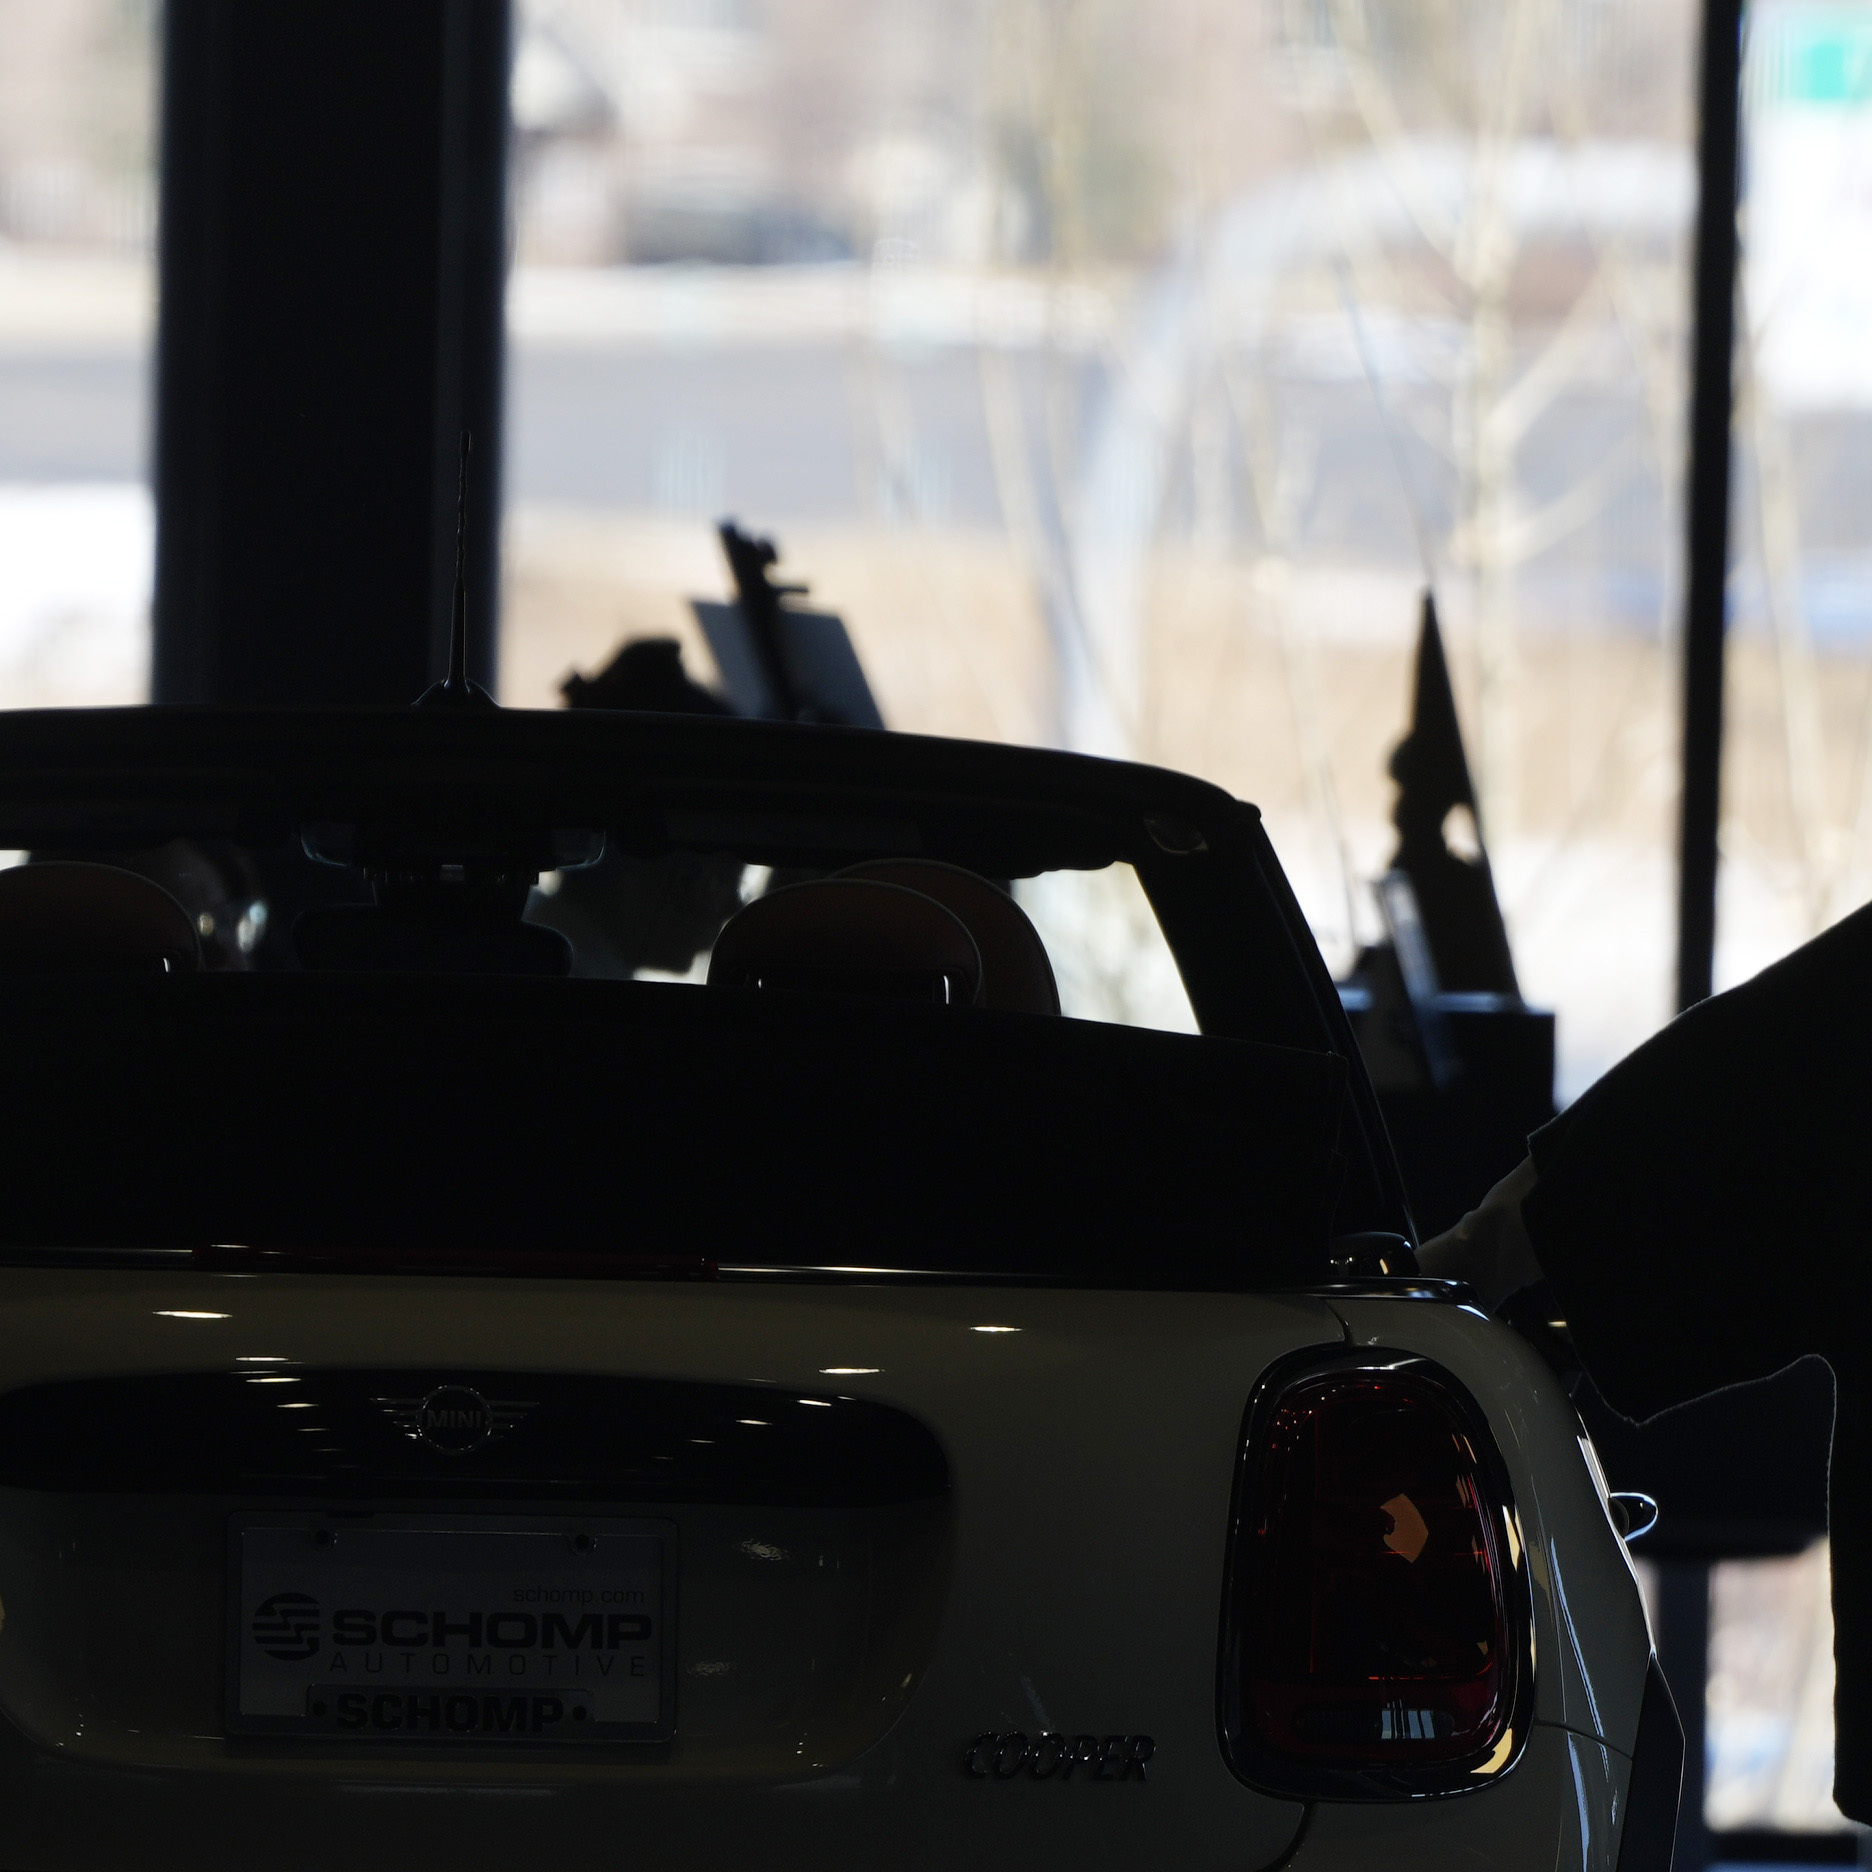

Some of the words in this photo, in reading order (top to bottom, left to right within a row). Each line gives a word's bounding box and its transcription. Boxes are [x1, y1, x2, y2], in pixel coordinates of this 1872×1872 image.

[426, 1409, 482, 1429] MINI
[514, 1585, 645, 1605] schomp.com
[332, 1609, 653, 1650] SCHOMP
[329, 1651, 645, 1677] AUTOMOTIVE
[336, 1692, 564, 1733] SCHOMP
[966, 1731, 1156, 1781] COOPER
